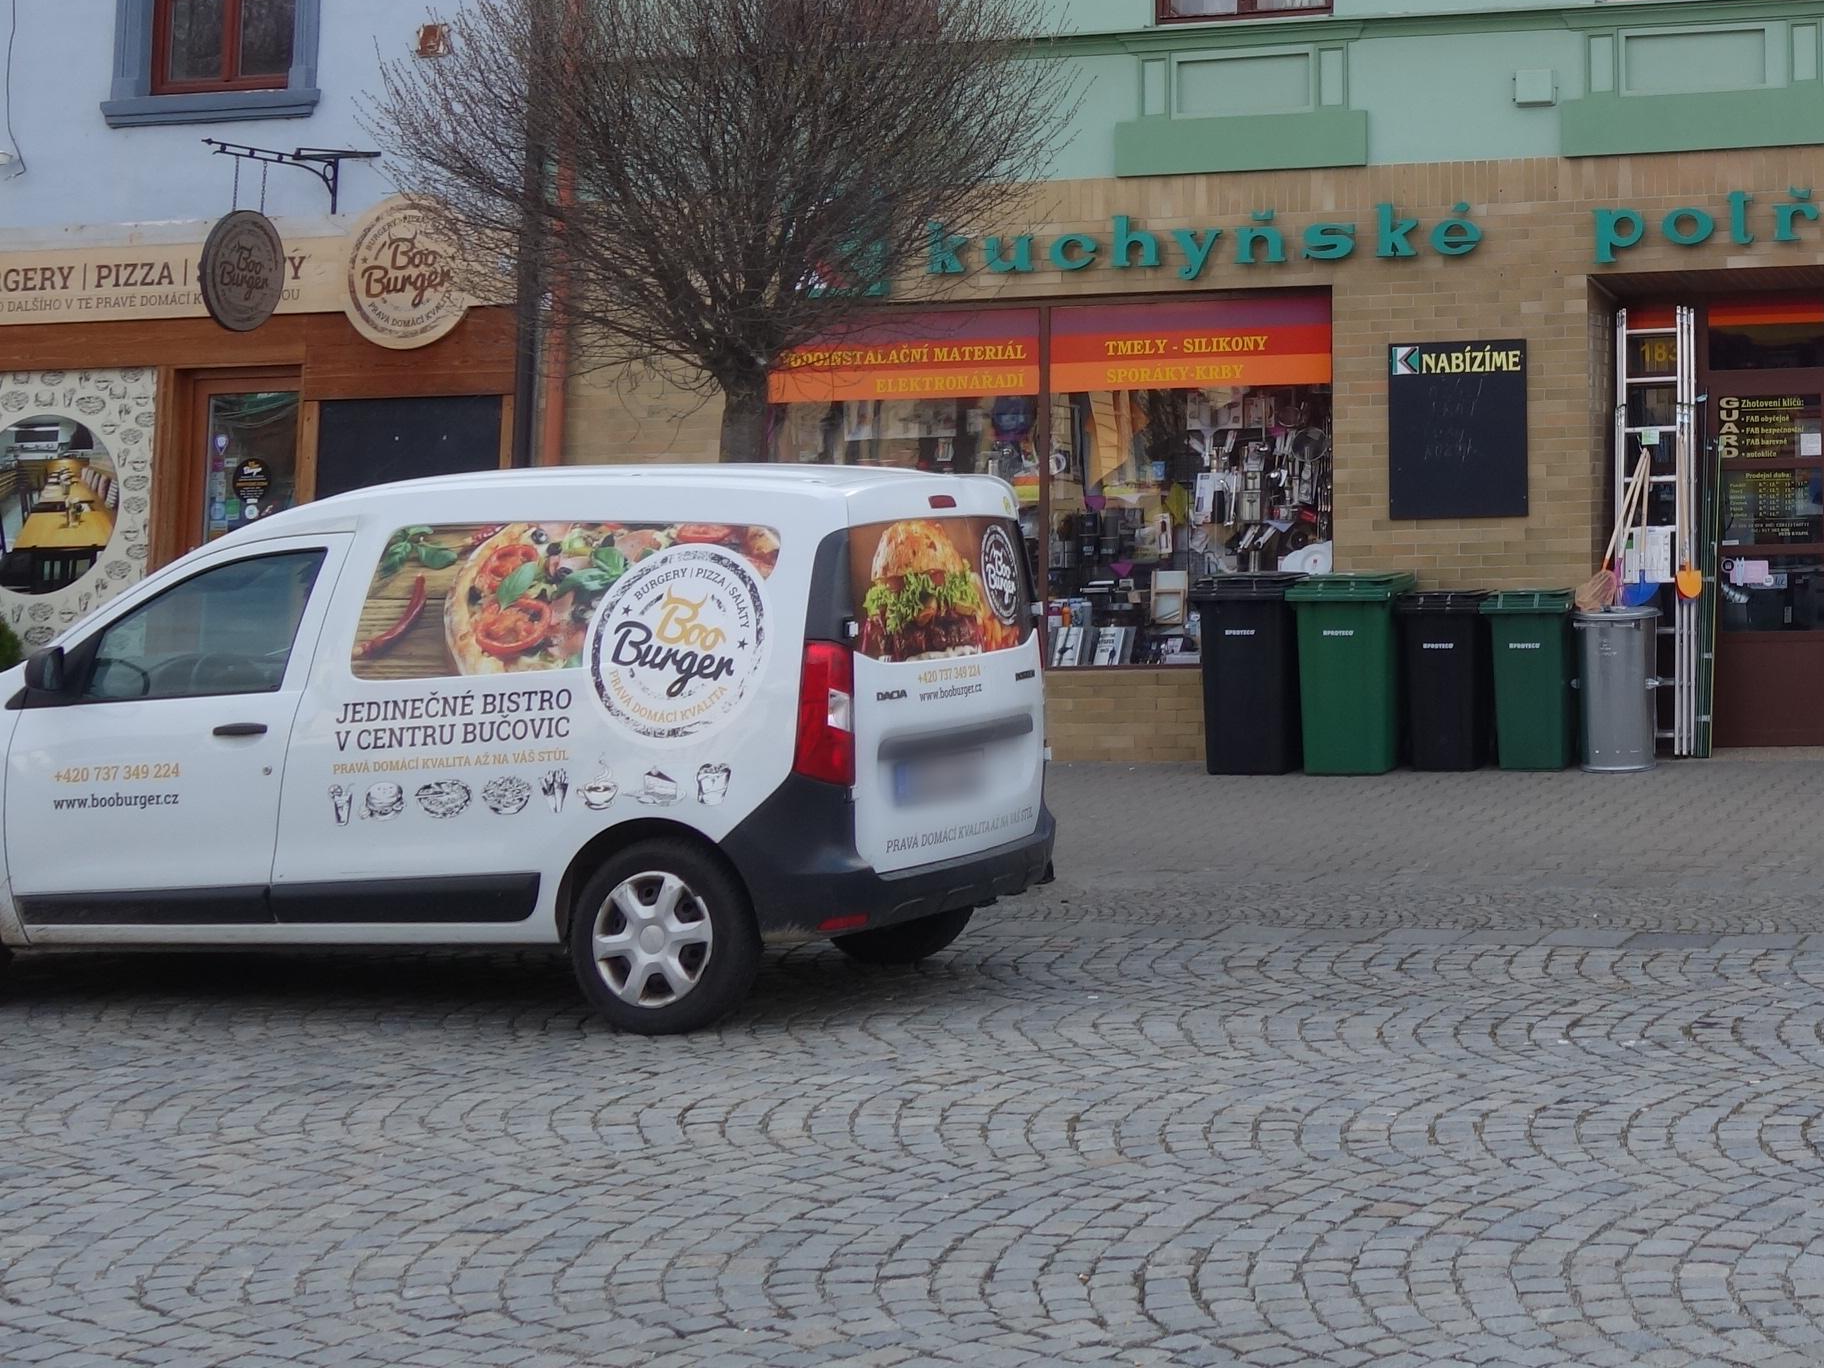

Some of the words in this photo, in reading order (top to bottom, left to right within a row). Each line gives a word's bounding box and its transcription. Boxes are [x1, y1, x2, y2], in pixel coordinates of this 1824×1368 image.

[388, 230, 442, 270] Boo
[927, 202, 1483, 280] kuchyňské
[0, 265, 75, 292] GERY
[95, 262, 174, 288] PIZZA
[65, 299, 74, 310] V
[140, 292, 191, 307] DOMÁCÍ
[933, 340, 1026, 363] MATERIÁL
[1105, 339, 1168, 356] TMELY
[1183, 335, 1268, 353] SILIKONY
[1422, 345, 1521, 374] NABÍZÍME
[1741, 398, 1781, 408] Zhotovení
[1745, 415, 1760, 423] FAB
[1745, 427, 1760, 435] FAB
[1745, 438, 1760, 446] FAB
[634, 568, 687, 601] BURGERY
[696, 568, 726, 588] PIZZA
[728, 586, 750, 629] SALÁTY
[656, 584, 727, 652] Boo
[611, 620, 734, 697] Burger
[609, 670, 632, 706] PRAVÁ
[680, 685, 728, 721] KVALITA
[876, 689, 908, 702] DACIA
[919, 683, 983, 703] www.booburger.cz
[336, 690, 474, 724] JEDINEČNÉ
[481, 688, 572, 715] BISTRO
[336, 730, 350, 752] V
[357, 724, 456, 750] CENTRU
[461, 715, 570, 744] BUČOVIC
[54, 767, 89, 783] +420
[94, 765, 120, 781] 737
[123, 763, 149, 780] 349
[153, 762, 180, 779] 224
[333, 759, 370, 775] PRAVÁ
[373, 755, 420, 772] DOMÁCÍ
[422, 753, 472, 770] KVALITA
[474, 751, 490, 766] AŽ
[493, 751, 509, 765] NA
[513, 750, 535, 764] VÁŠ
[53, 792, 180, 810] www.booburger.cz
[885, 834, 919, 854] PRAVÁ
[920, 824, 957, 848] DOMÁCÍ
[957, 820, 990, 840] KVALITA
